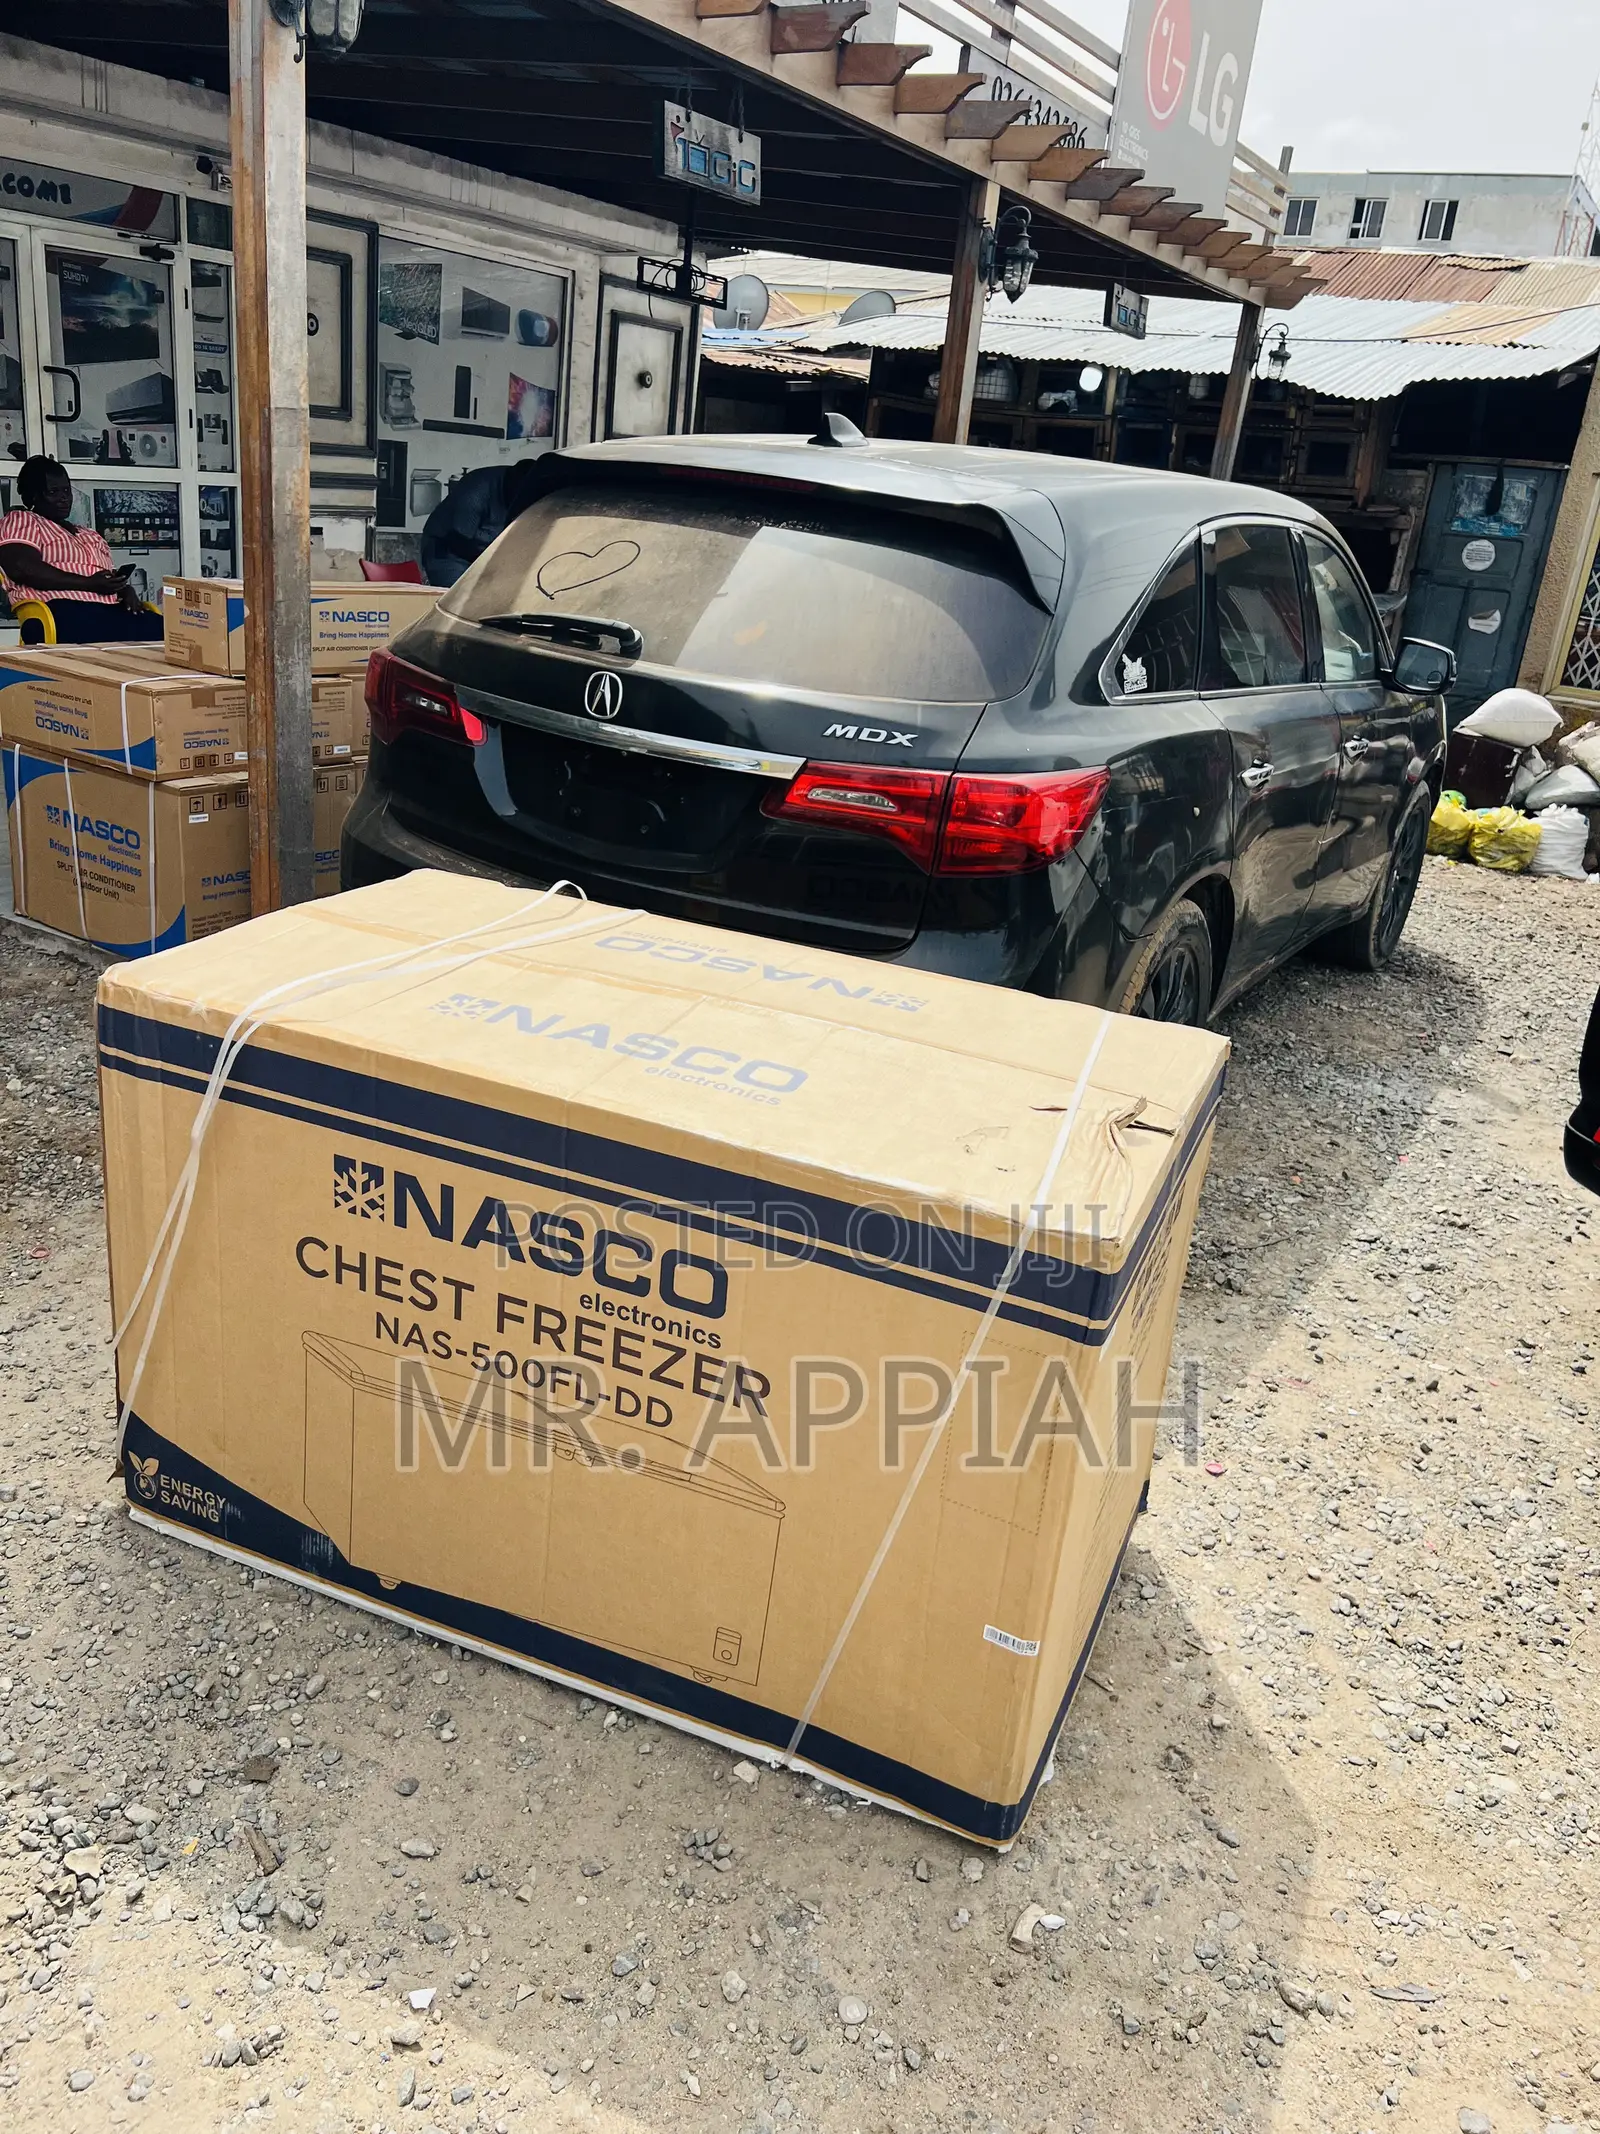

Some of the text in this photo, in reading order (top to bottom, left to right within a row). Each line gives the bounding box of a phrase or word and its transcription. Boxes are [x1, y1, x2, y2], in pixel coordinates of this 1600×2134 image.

[1188, 30, 1239, 147] LG
[332, 611, 390, 622] NASCO
[320, 630, 390, 640] Bring Home Happiness
[35, 716, 79, 738] NASCO
[184, 738, 221, 749] NASCO
[823, 723, 920, 748] MDX
[62, 810, 140, 850] NASCO
[49, 838, 70, 856] Bring
[100, 854, 142, 877] Happiness
[108, 844, 140, 860] electronics
[57, 860, 74, 873] SPLIT
[89, 871, 136, 893] CONDITIONER
[103, 887, 120, 900] Unit)
[622, 930, 728, 954] electronics
[595, 936, 876, 1000] NASCO
[483, 1004, 809, 1094] NASCO
[645, 1066, 782, 1106] electronics
[393, 1170, 729, 1320] NASCO
[295, 1235, 772, 1418] CHEST FREEZER
[579, 1290, 722, 1350] electronics
[375, 1311, 674, 1428] NAS-500FL-DD
[160, 1474, 226, 1509] ENERGY
[160, 1490, 220, 1523] SAVING
